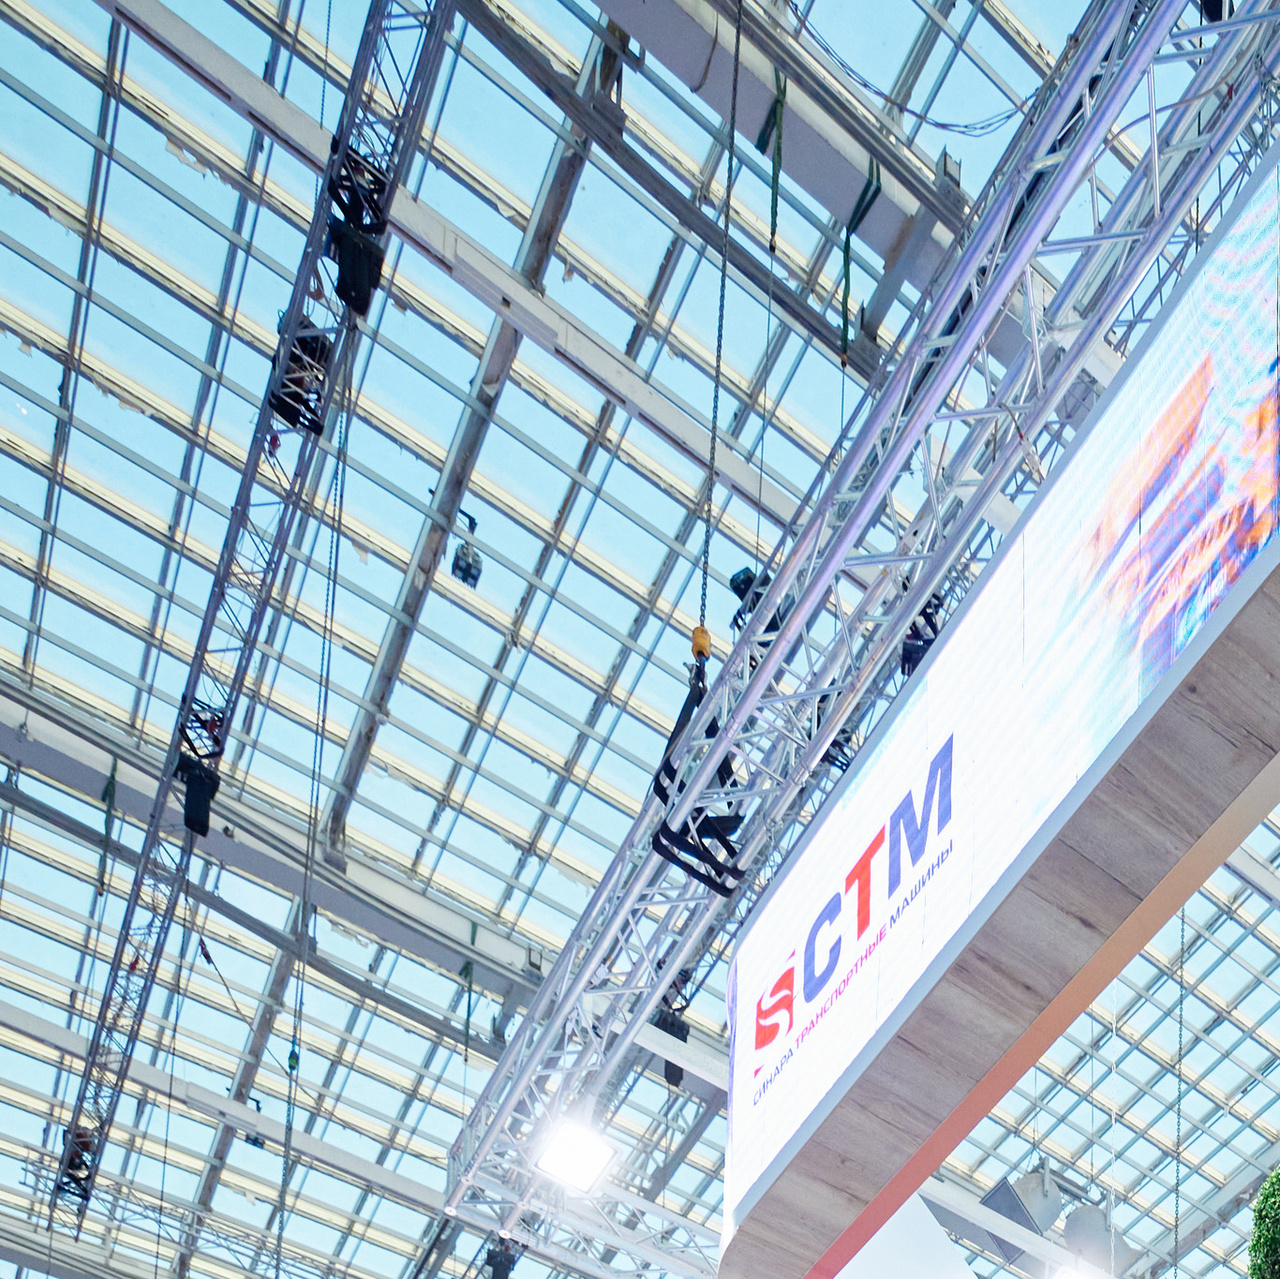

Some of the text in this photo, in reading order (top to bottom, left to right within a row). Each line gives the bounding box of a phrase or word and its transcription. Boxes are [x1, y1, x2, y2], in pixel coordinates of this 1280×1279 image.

[753, 838, 954, 1106] СИНАРА ТРАНСПОРТНЫЕ МАШИНЫ
